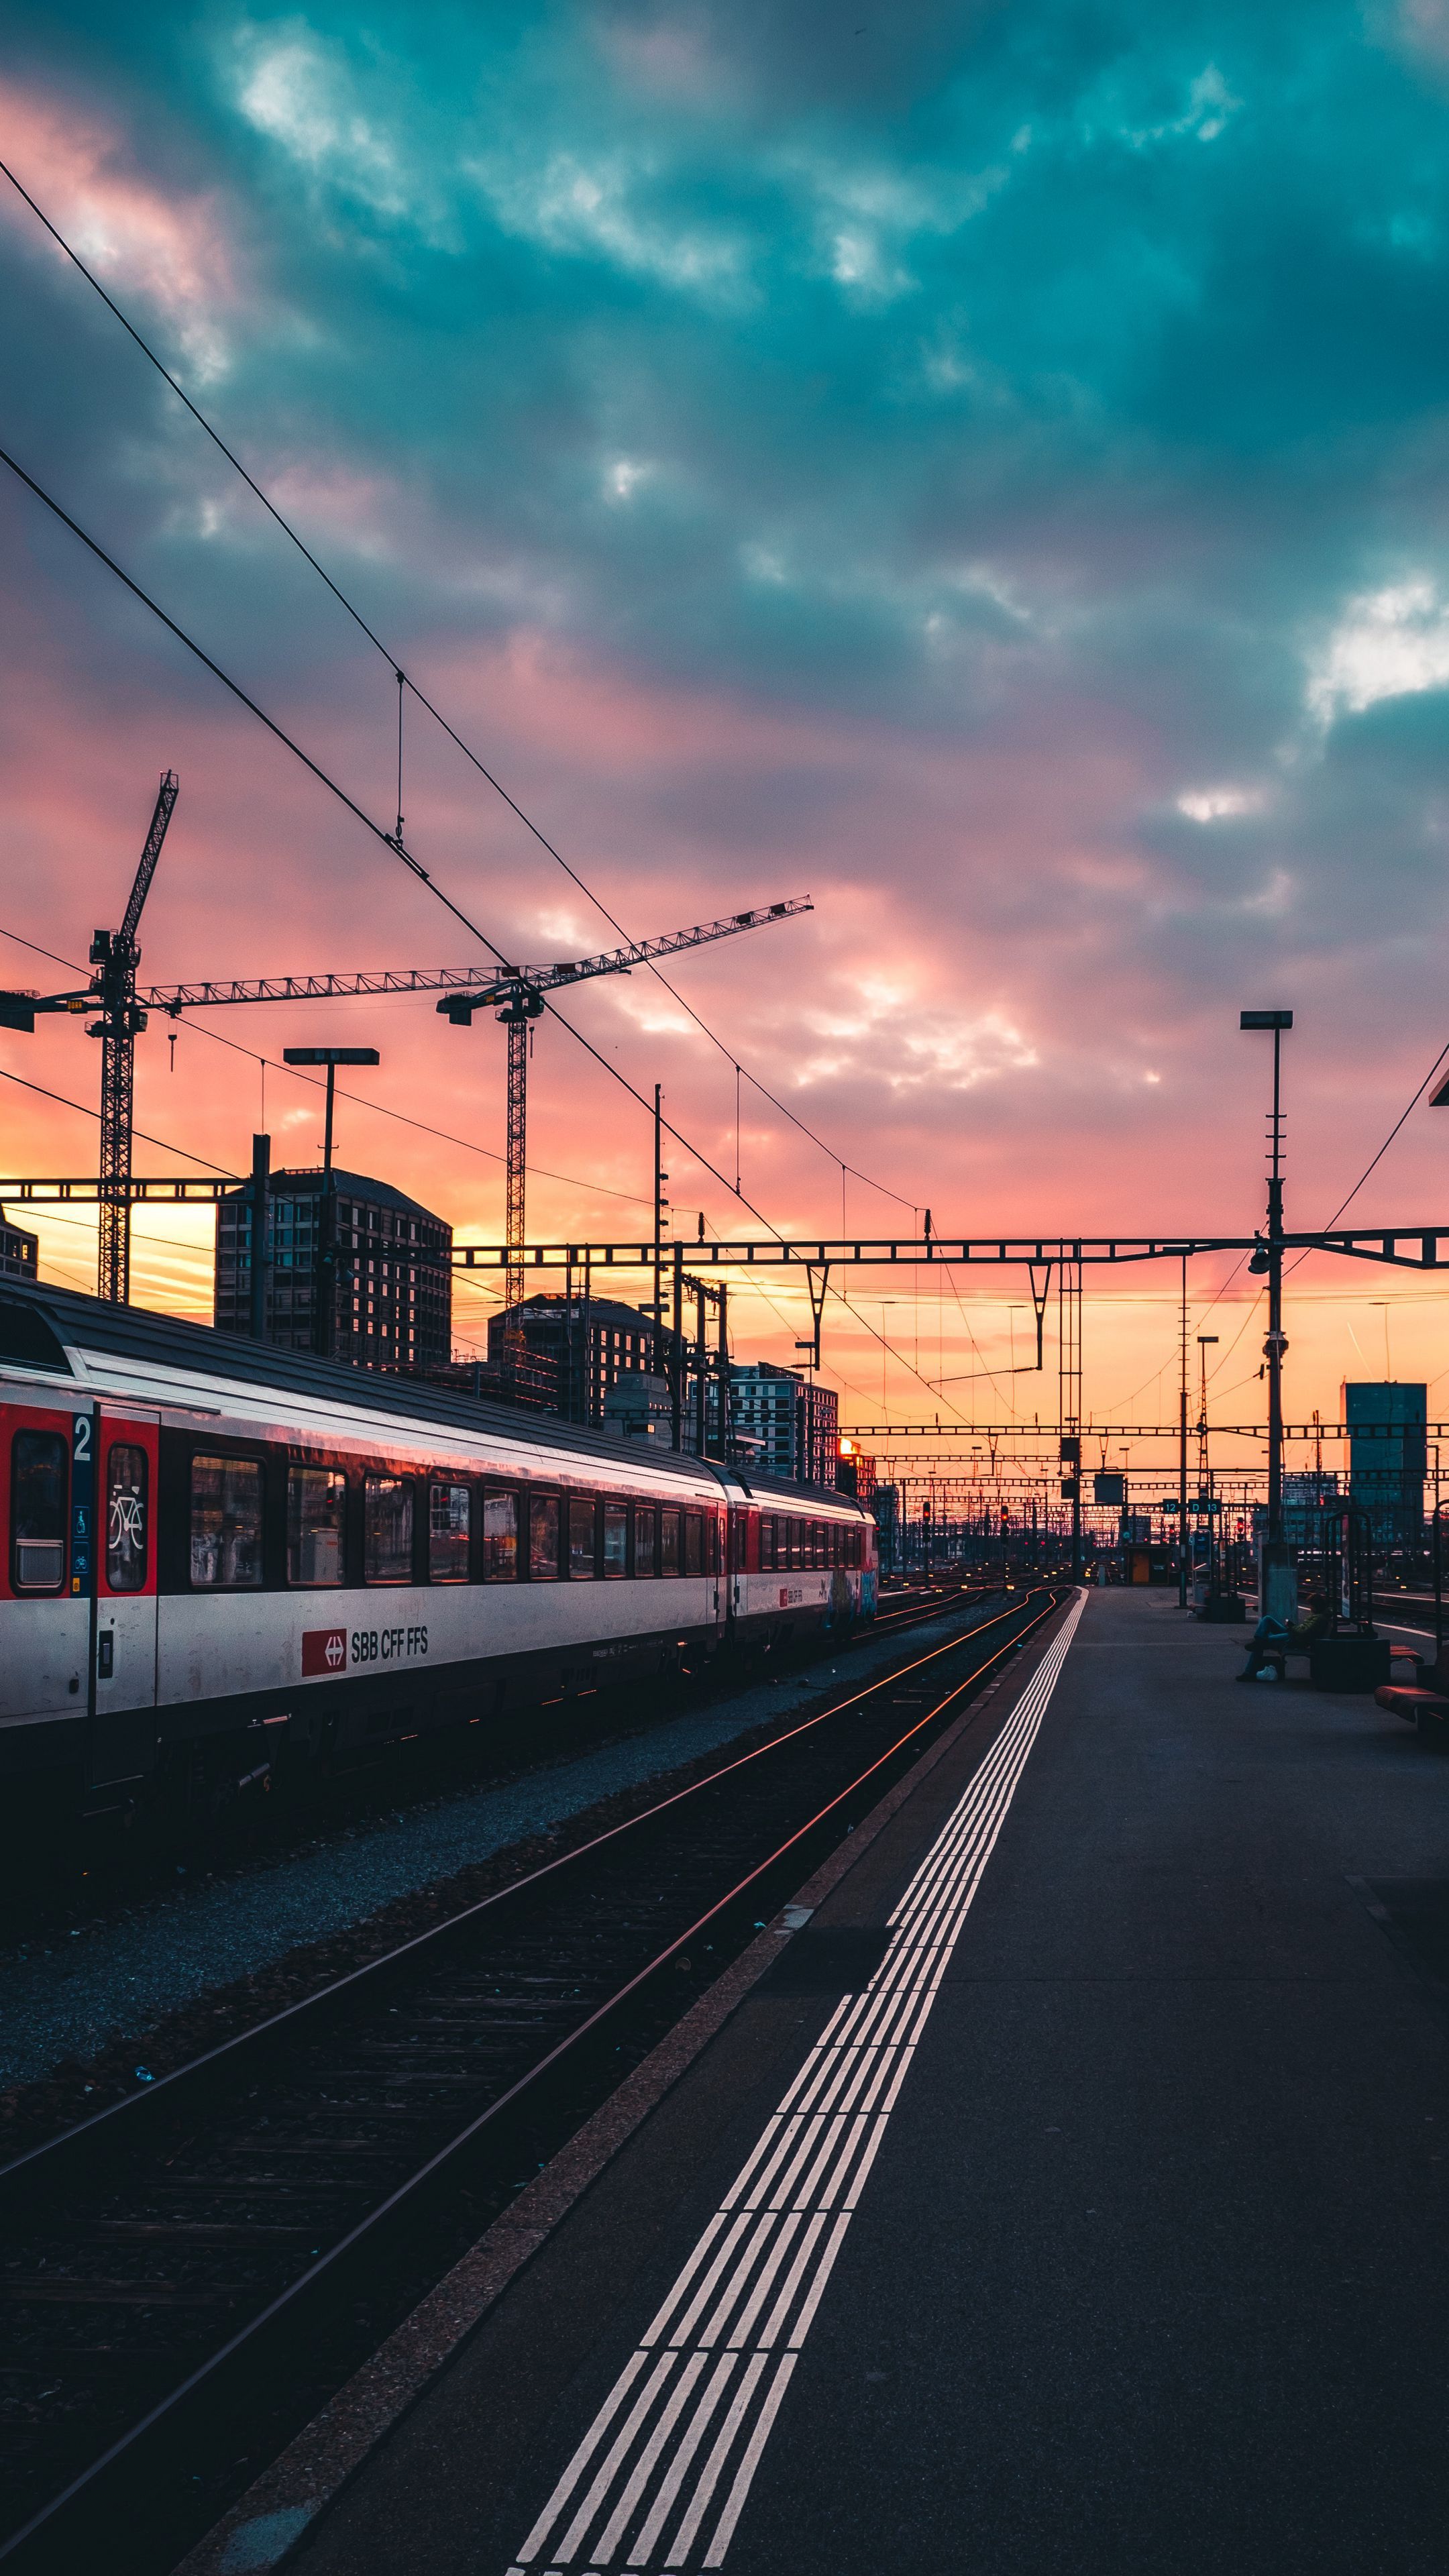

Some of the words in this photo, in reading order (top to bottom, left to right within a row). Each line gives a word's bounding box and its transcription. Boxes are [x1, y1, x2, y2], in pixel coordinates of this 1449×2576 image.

[74, 1416, 91, 1461] 2
[1167, 1503, 1176, 1511] 12
[1193, 1503, 1200, 1511] D
[1207, 1503, 1218, 1511] 13
[352, 1631, 378, 1664] SBB
[381, 1629, 405, 1660] CFF
[407, 1625, 428, 1656] FFS
